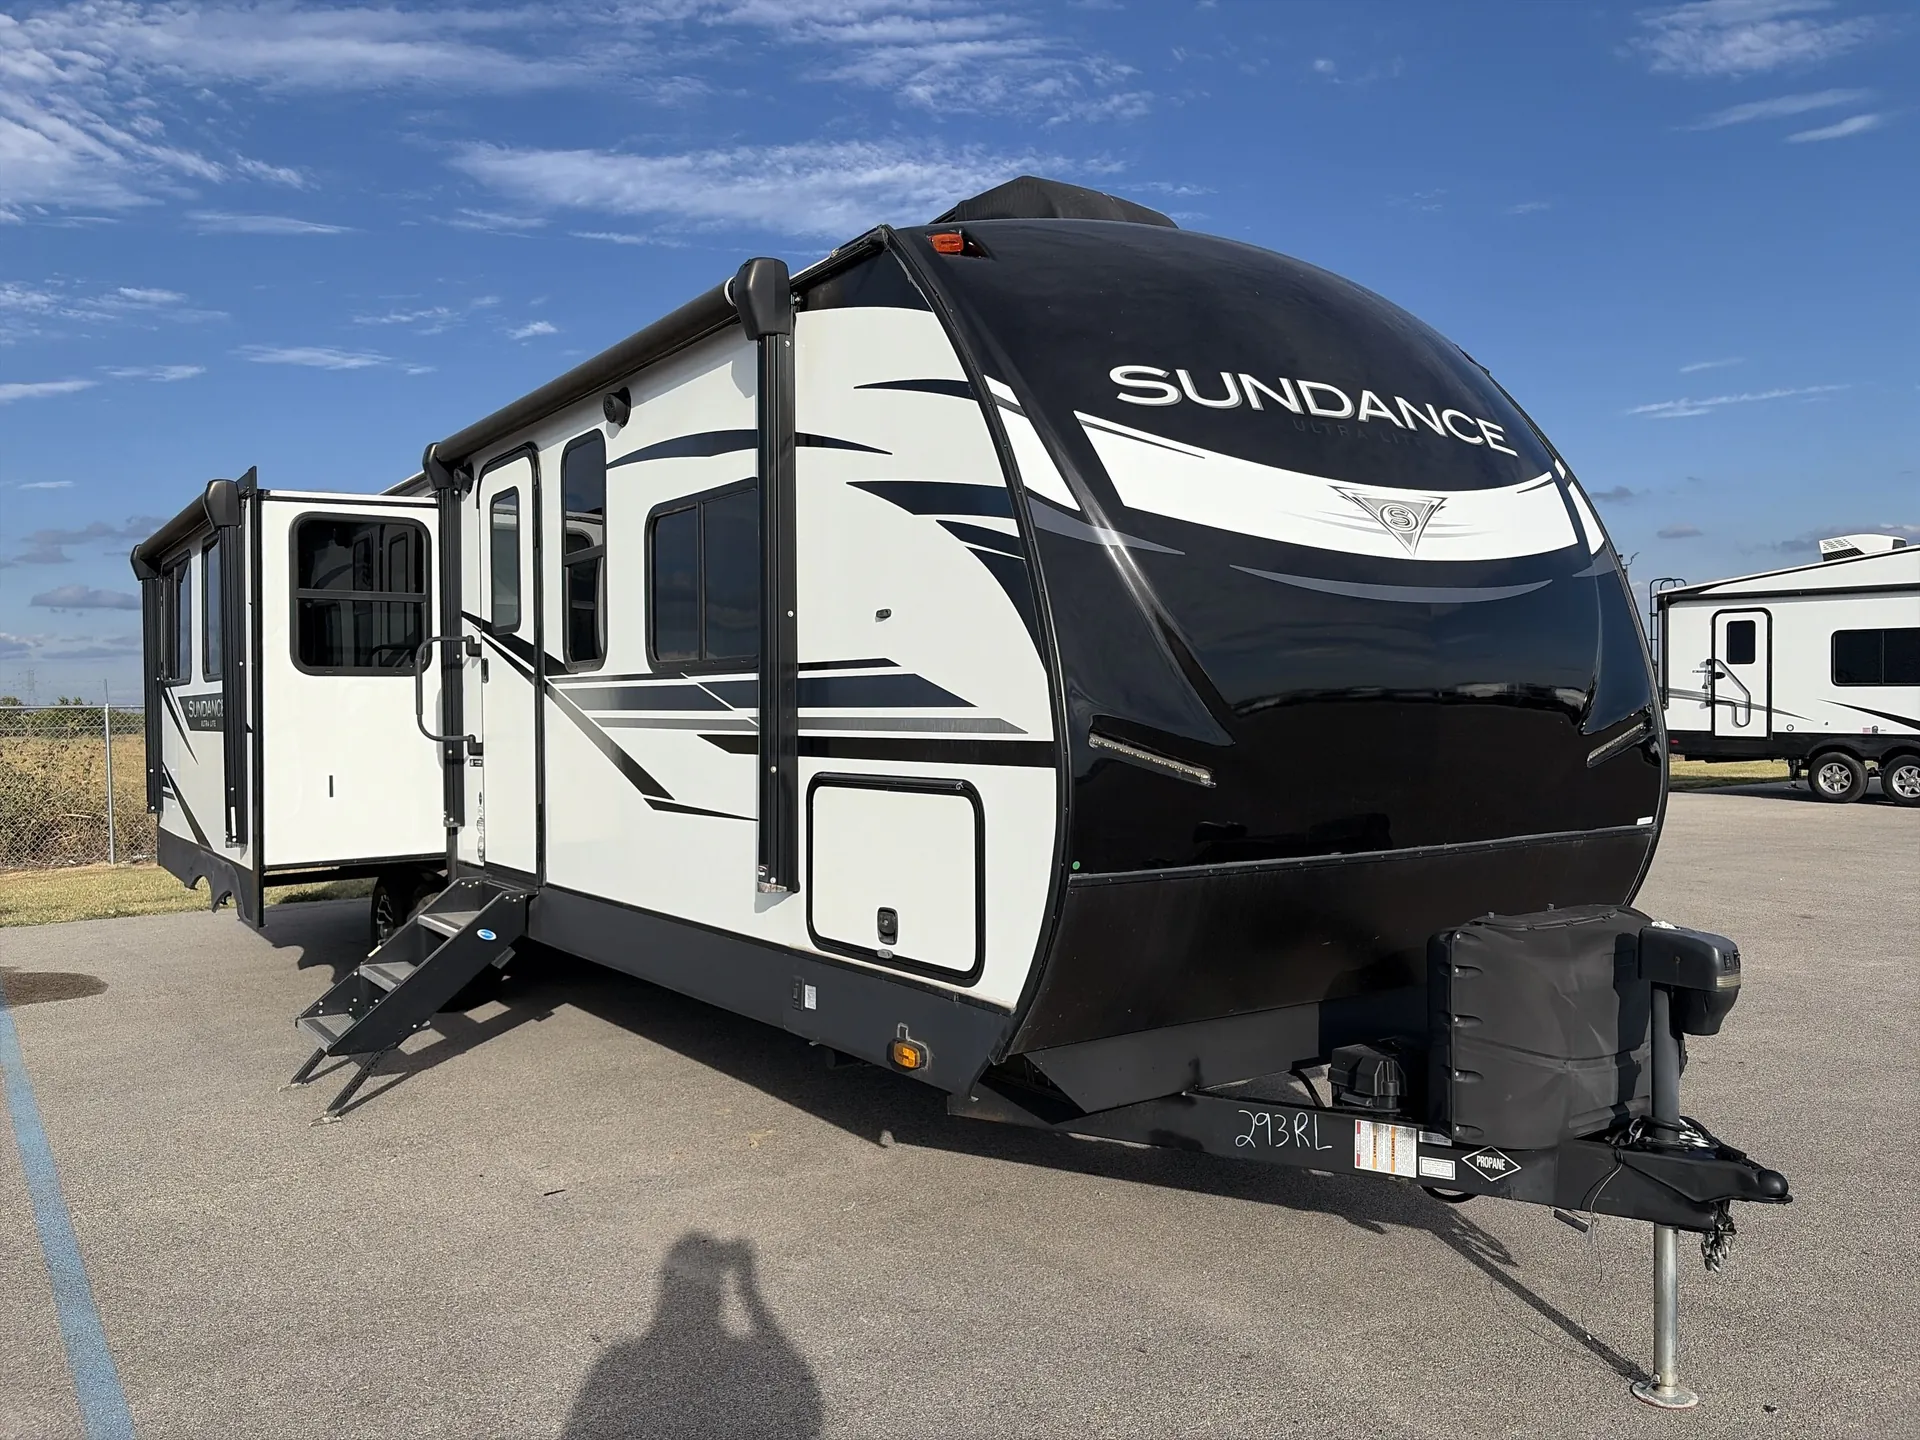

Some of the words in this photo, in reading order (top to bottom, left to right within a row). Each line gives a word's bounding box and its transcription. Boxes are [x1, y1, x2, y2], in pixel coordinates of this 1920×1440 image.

[1109, 365, 1519, 457] SUNDANCE
[1292, 419, 1369, 440] ULTRA
[1235, 1109, 1333, 1151] 293RL
[1476, 1155, 1506, 1171] PROPANE
